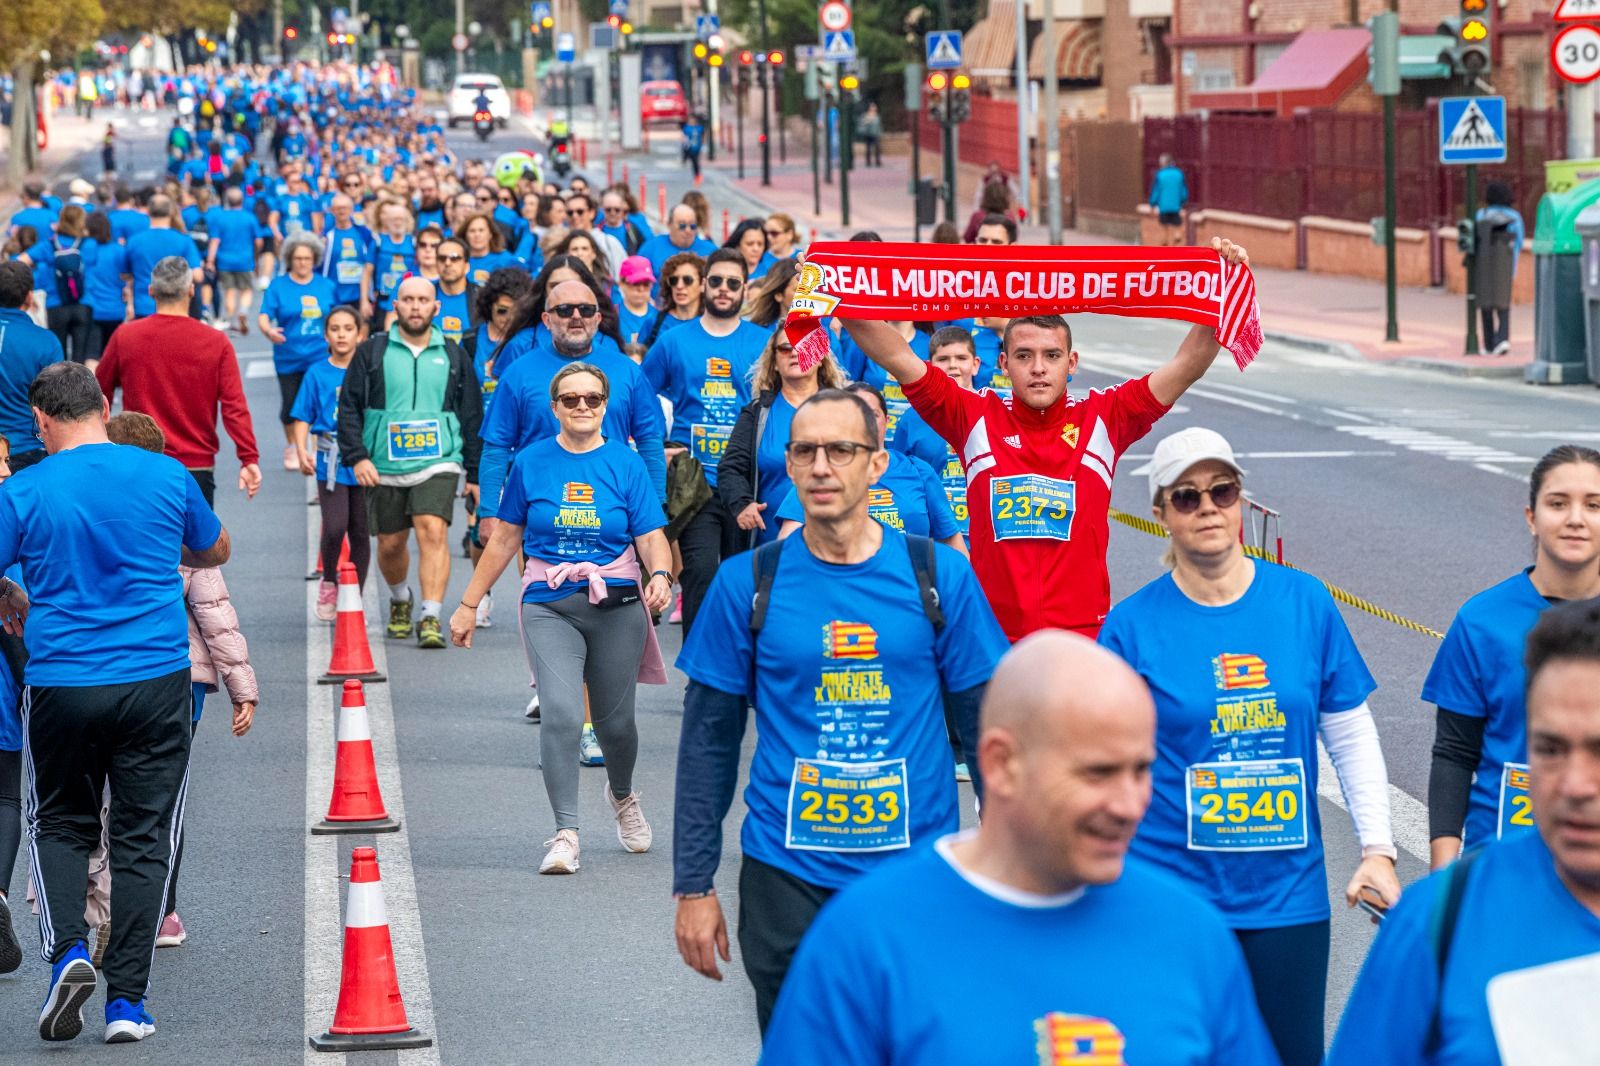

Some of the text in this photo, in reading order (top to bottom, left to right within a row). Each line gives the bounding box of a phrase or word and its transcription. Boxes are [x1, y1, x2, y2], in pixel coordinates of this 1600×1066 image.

[1564, 43, 1598, 64] 30
[820, 264, 1221, 303] REAL MURCIA CLUB DE FÚTBOL
[912, 303, 950, 311] COMO
[393, 432, 436, 448] 1285
[997, 495, 1067, 520] 2373
[815, 684, 892, 702] X VALENCIA
[1210, 719, 1219, 734] X
[1221, 712, 1287, 734] VALENCIA
[799, 790, 900, 825] 2533
[1199, 789, 1297, 824] 2540
